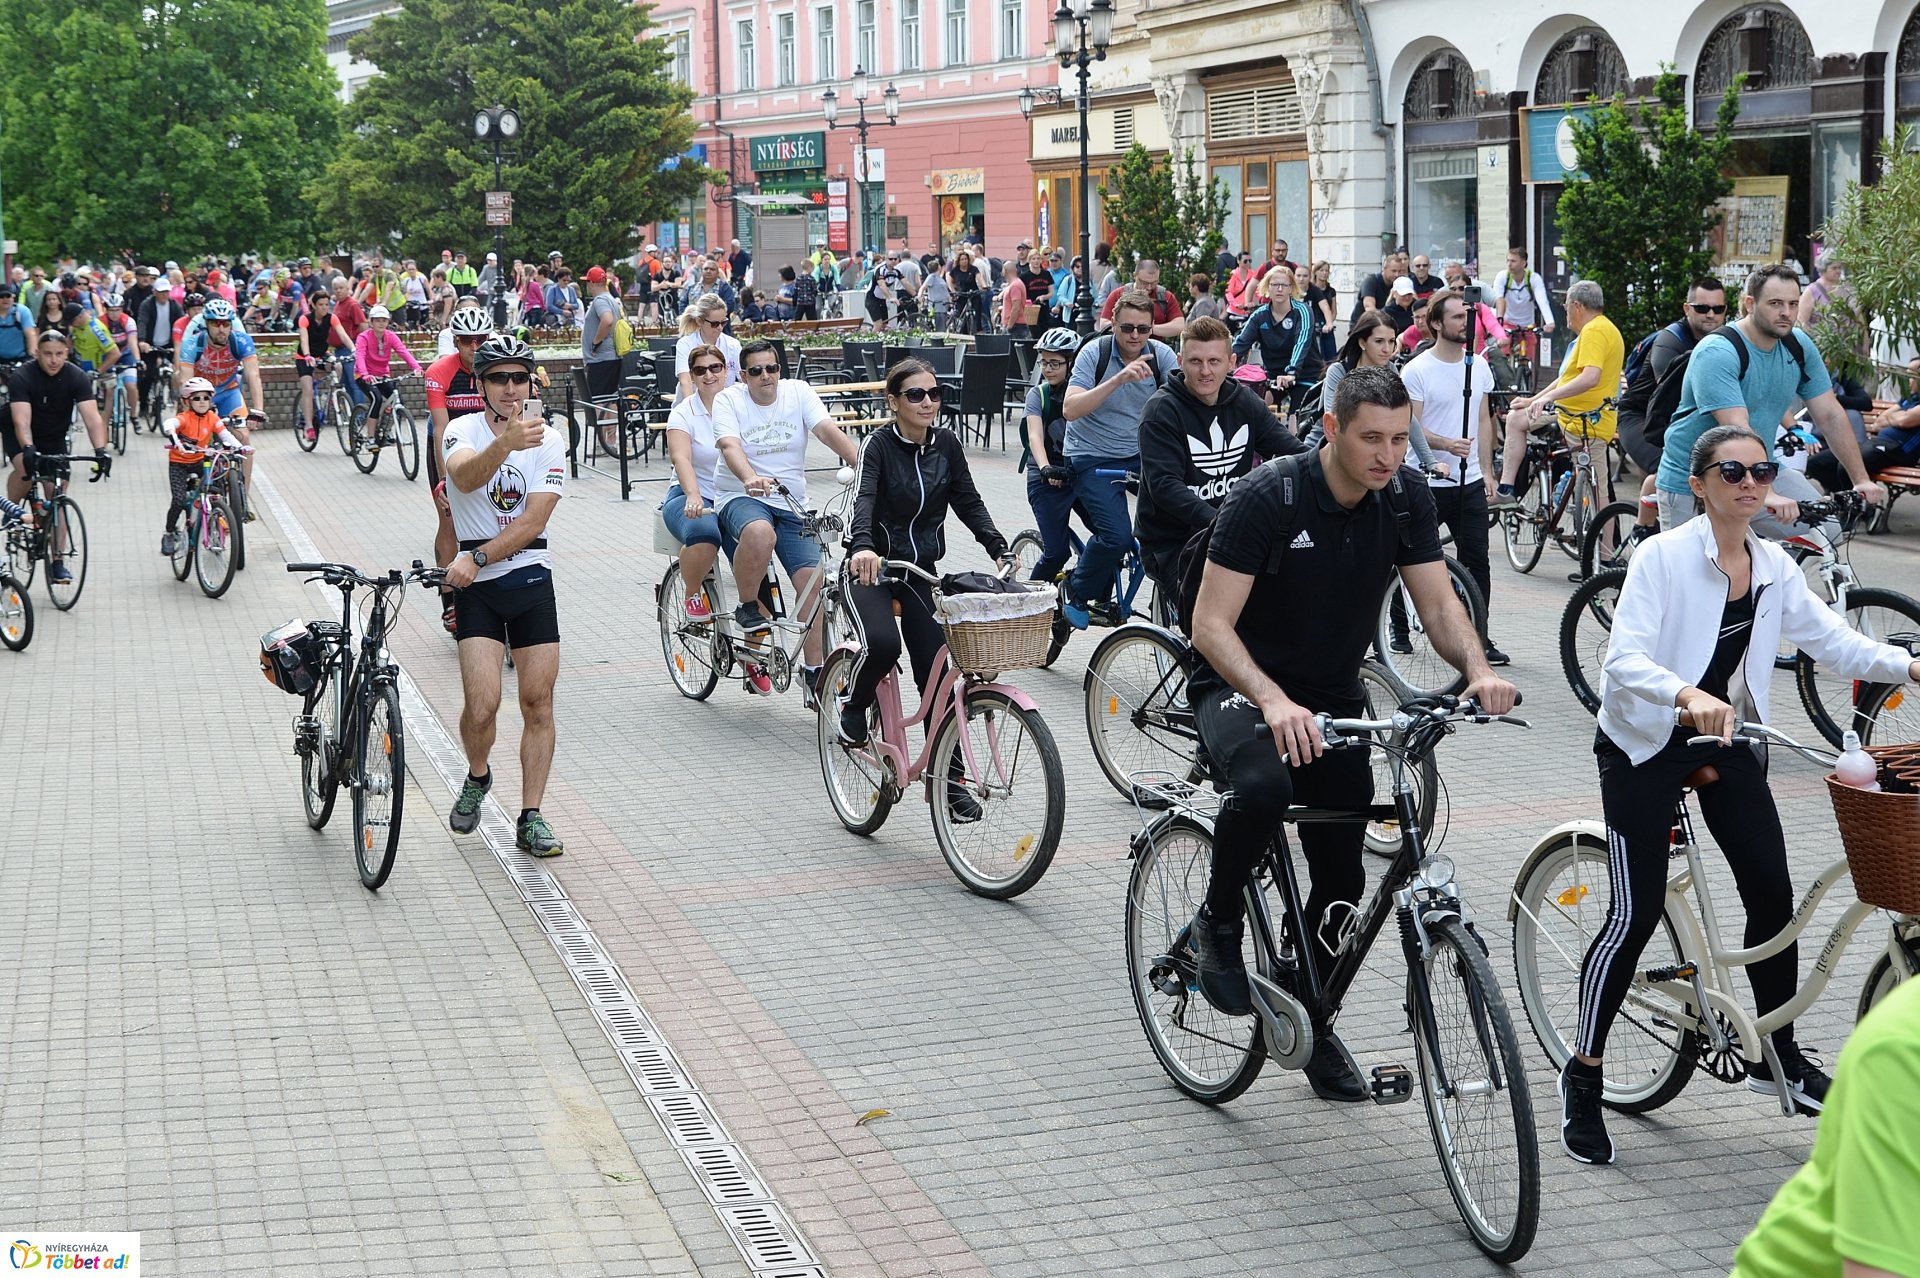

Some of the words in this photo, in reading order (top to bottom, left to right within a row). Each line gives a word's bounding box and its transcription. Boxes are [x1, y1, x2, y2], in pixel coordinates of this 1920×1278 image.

[757, 136, 815, 161] NYÍRSÉG
[545, 479, 563, 487] HUN
[1290, 541, 1315, 549] adidas
